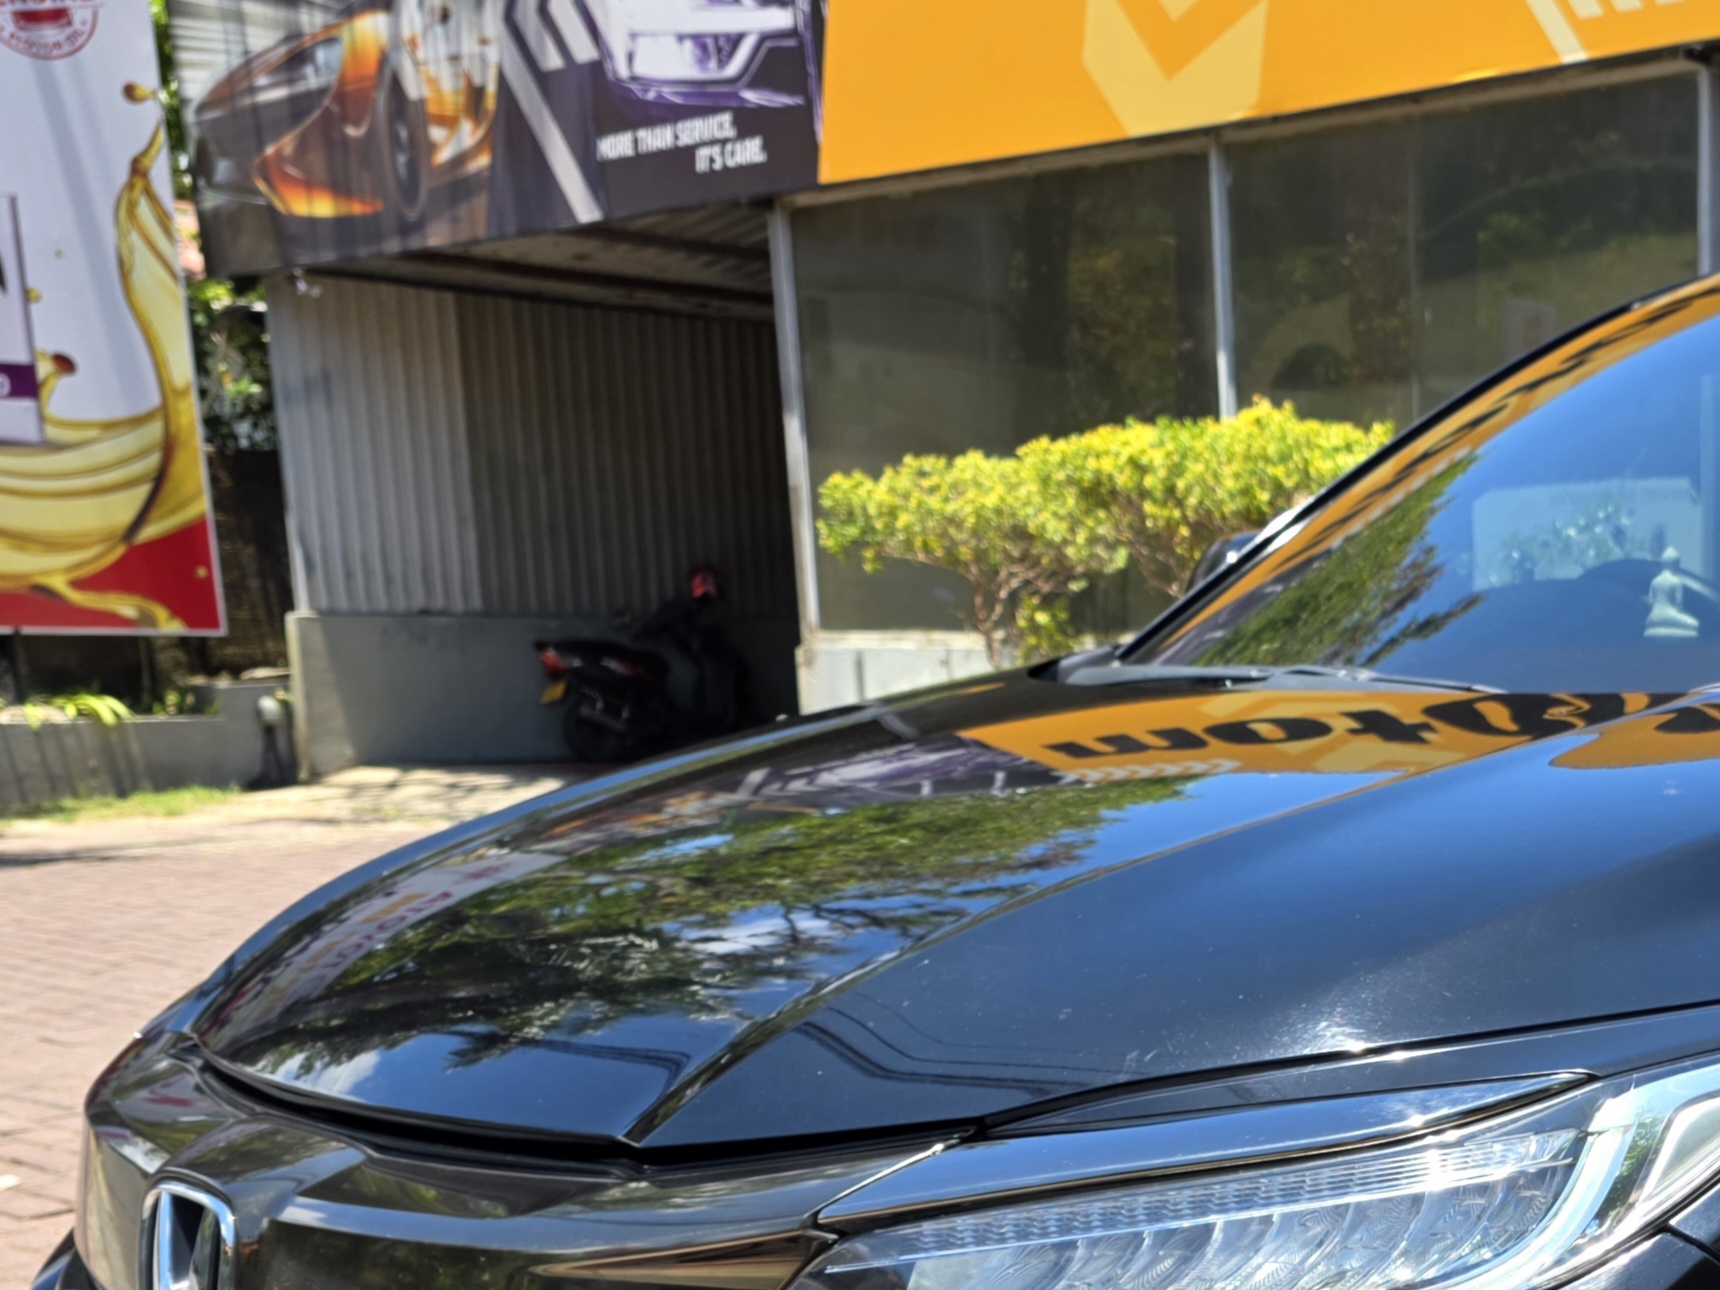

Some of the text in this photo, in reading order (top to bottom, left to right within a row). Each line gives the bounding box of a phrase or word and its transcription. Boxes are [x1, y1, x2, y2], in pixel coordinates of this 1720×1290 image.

[597, 110, 738, 162] MORE THAN SERVICE.
[695, 134, 768, 174] IT'S CARE.
